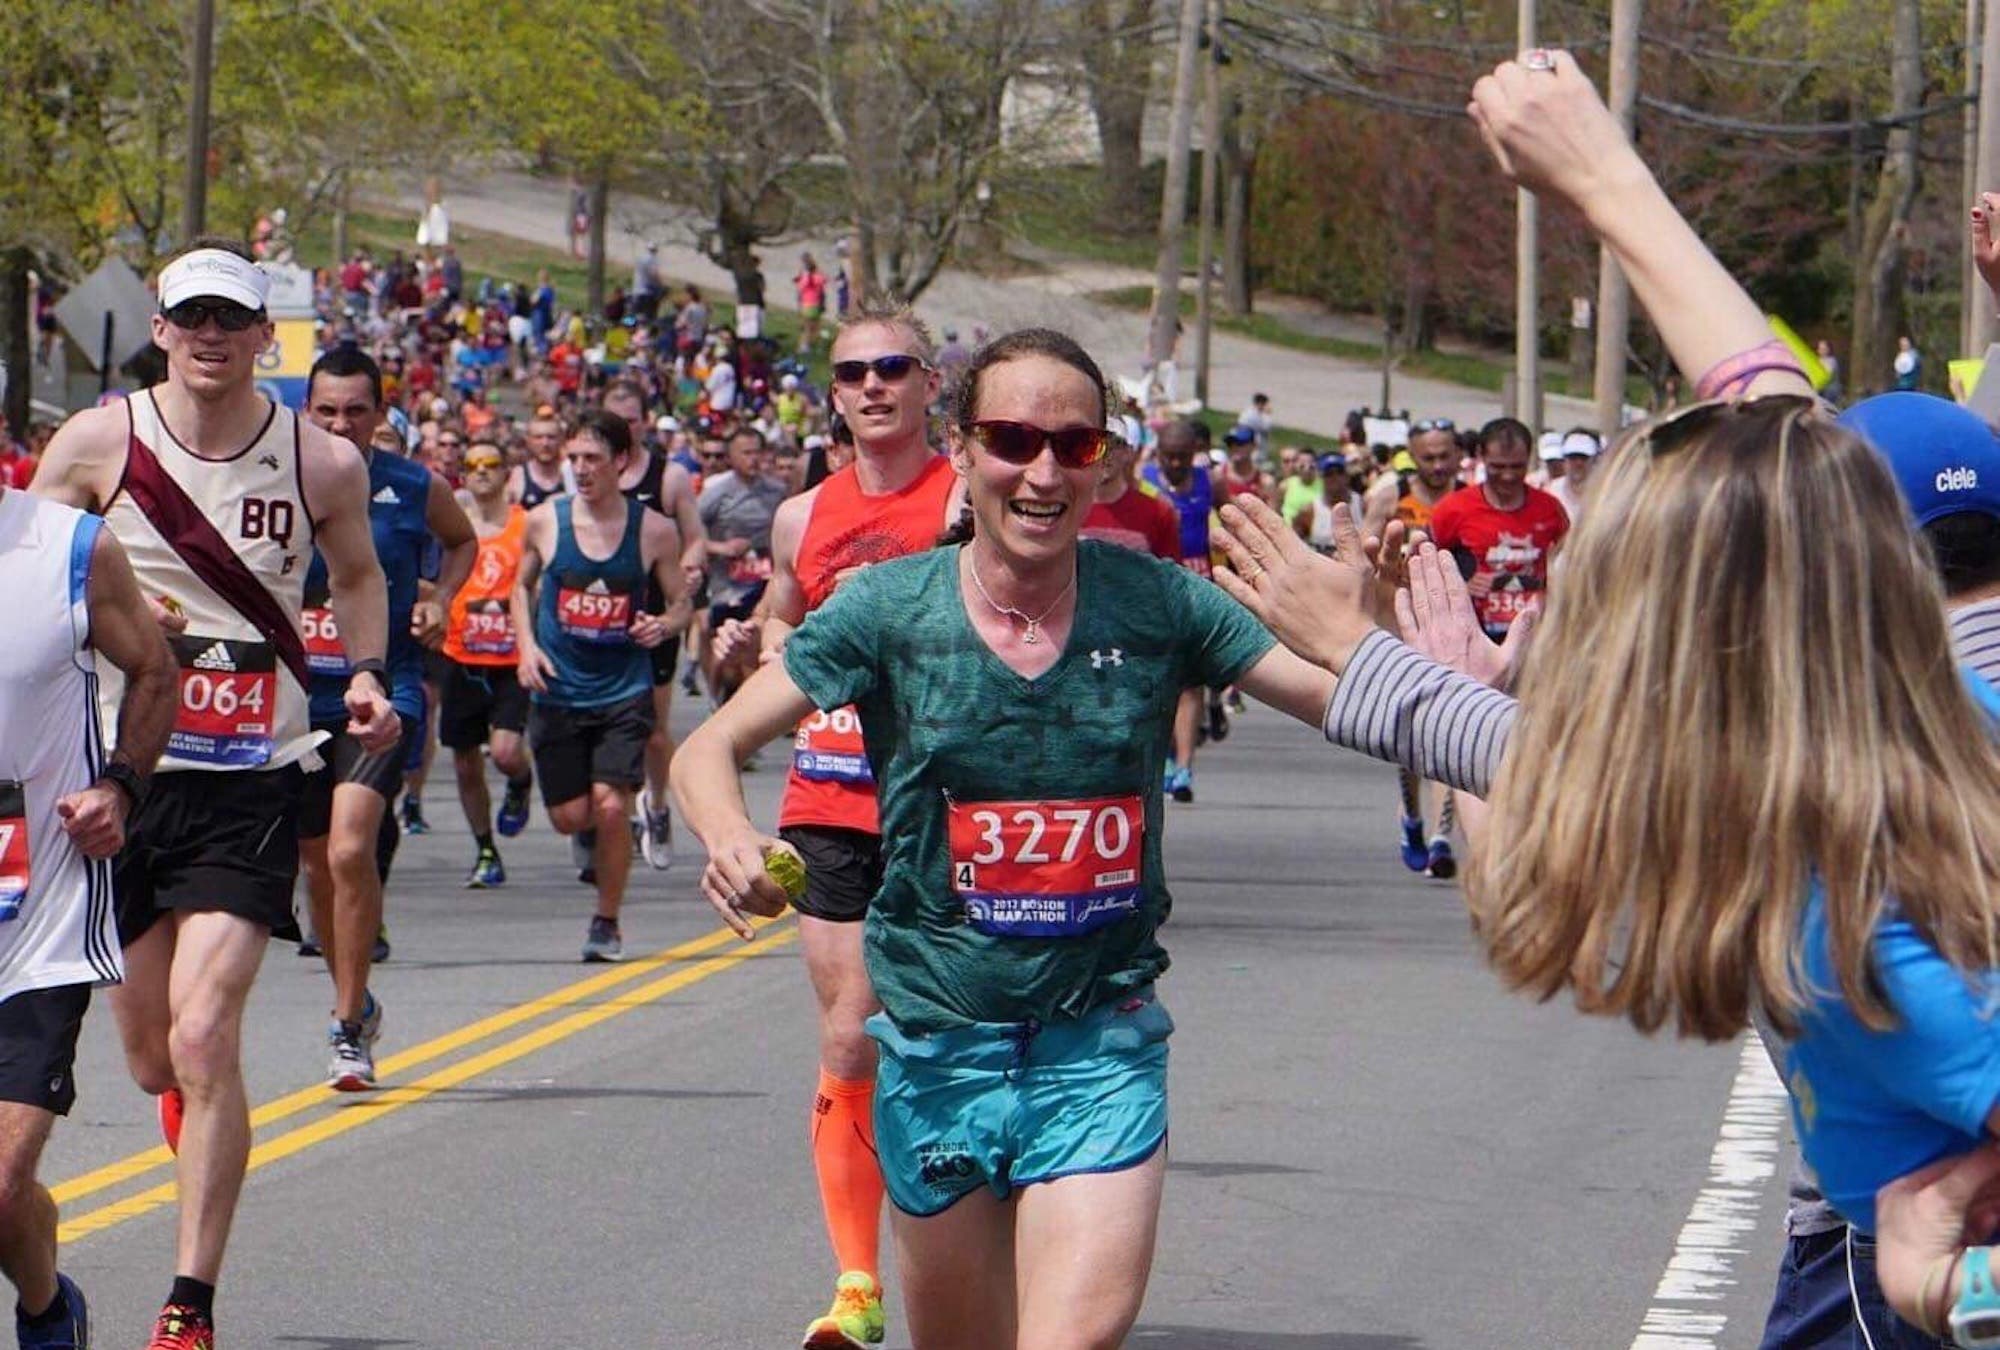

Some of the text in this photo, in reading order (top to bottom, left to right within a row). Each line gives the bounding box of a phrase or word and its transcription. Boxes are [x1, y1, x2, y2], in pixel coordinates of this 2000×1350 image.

[241, 497, 293, 549] BQ
[565, 593, 627, 618] 4597
[971, 805, 1130, 865] 3270
[958, 864, 974, 888] 4
[992, 910, 1066, 923] MARATHON
[1020, 898, 1066, 911] BOSTON
